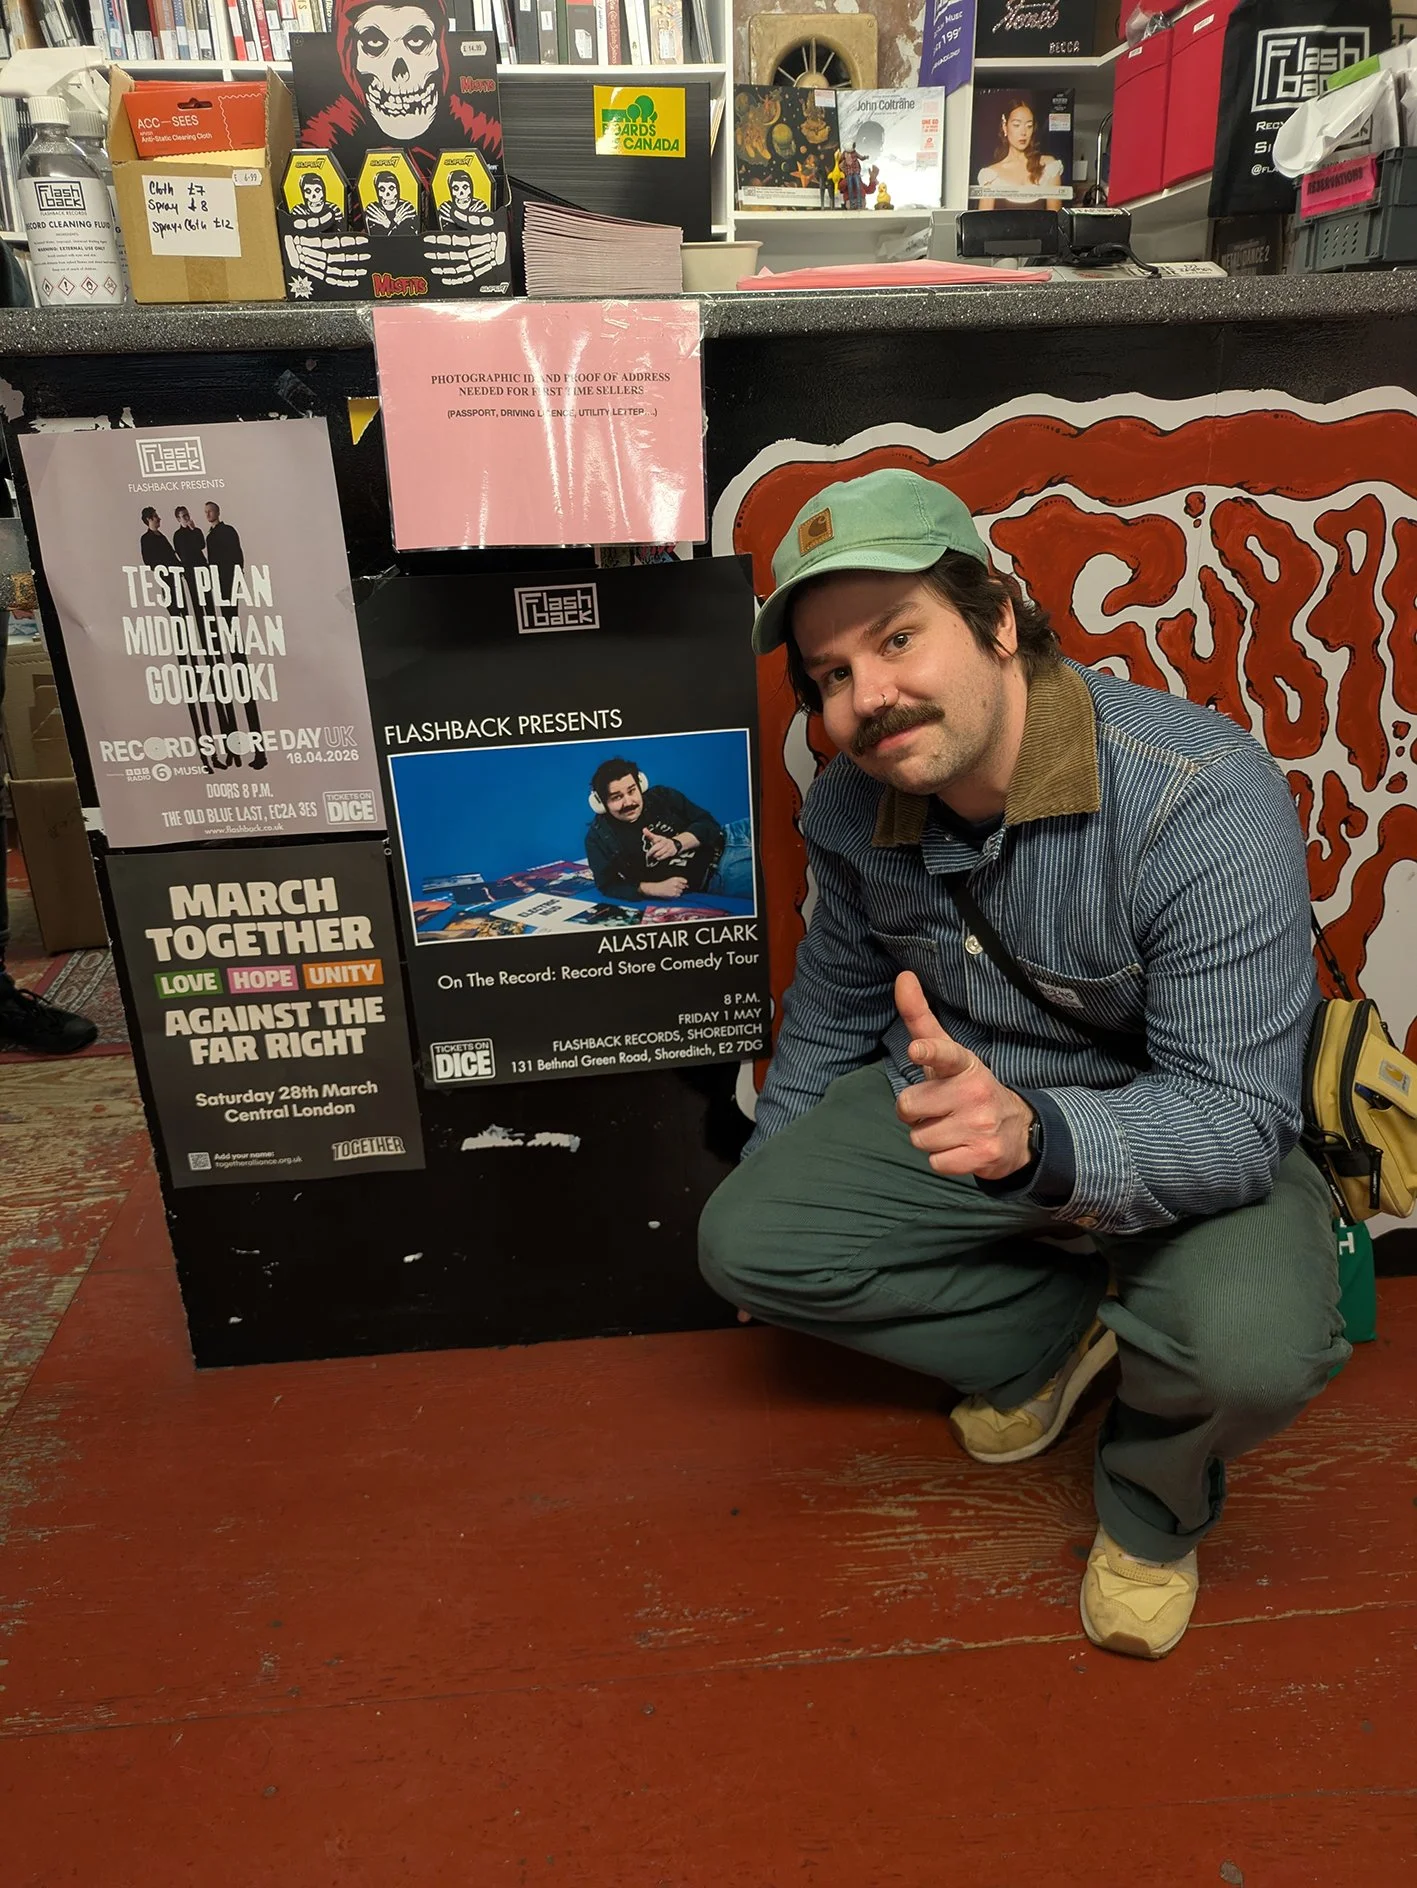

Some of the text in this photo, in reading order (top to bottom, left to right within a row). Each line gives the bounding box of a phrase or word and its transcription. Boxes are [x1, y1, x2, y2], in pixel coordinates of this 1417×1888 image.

[1262, 36, 1360, 100] Flash
[1276, 59, 1332, 98] bac
[857, 98, 915, 111] John Coltrane
[624, 137, 680, 152] CANADA
[38, 185, 80, 207] Flash
[149, 181, 206, 196] Cloth £7
[45, 193, 82, 207] back
[148, 199, 179, 215] Spray
[49, 220, 92, 229] CLEANING
[94, 221, 111, 229] FLUID
[213, 217, 234, 230] £12
[431, 373, 520, 384] PHOTOGRAPHIC
[523, 373, 535, 383] ID
[564, 372, 601, 382] POOF
[603, 371, 618, 382] OF
[621, 371, 671, 382] ADDRESS
[459, 385, 645, 396] NEEDED FOR FRST IME SELLERS
[447, 408, 499, 419] (PASSPORT,
[500, 409, 535, 417] DRIVING
[537, 409, 577, 418] LCENCE,
[579, 408, 610, 417] UTILITY
[141, 442, 199, 472] Flash
[151, 453, 200, 473] back
[128, 479, 226, 493] FLASHBACK PRESENTS
[122, 564, 274, 609] TEST PLAN
[523, 591, 593, 628] Flash
[533, 604, 593, 628] back
[122, 614, 287, 657] MIDDLEMAN
[145, 662, 279, 705] GODZOOKI
[384, 708, 623, 746] FLASHBACK PRESENTS
[99, 725, 358, 763] RECORD STORE DAY UK
[286, 750, 360, 765] 18.04.2026
[127, 774, 152, 782] RADIO
[154, 764, 210, 780] 6 MUSIC
[206, 783, 274, 799] DOORS 8 P.M.
[326, 793, 358, 801] TICKETS
[162, 801, 318, 828] THE OLD BLUE LAST, EC2A 3ES
[328, 801, 375, 822] DICE
[204, 823, 284, 836] www.flashback.co.uk
[168, 876, 339, 921] MARCH
[145, 915, 375, 963] TOGETHER
[598, 923, 759, 955] ALASTAIR CLARK
[232, 969, 293, 990] HOPE
[308, 963, 377, 985] UNITY
[438, 951, 760, 990] On The Record: Record Store Comedy Tour
[159, 971, 218, 994] LOVE
[724, 992, 761, 1005] 8 P.M.
[164, 996, 386, 1038] AGAINST THE
[678, 1008, 762, 1025] FRIDAY 1 MAY
[189, 1027, 368, 1066] FAR RIGHT
[435, 1041, 490, 1053] TICKETS ON
[553, 1022, 763, 1053] FLASHBACK RECORDS, SHOREDITCH
[436, 1051, 492, 1080] DICE
[511, 1038, 763, 1074] 131 Bethnal Green Road, Shoreditch, E2 7DG
[195, 1080, 378, 1107] Saturday 28th March
[225, 1101, 356, 1123] Central London
[214, 1151, 275, 1161] Add your name:
[332, 1136, 406, 1161] TOGETHER
